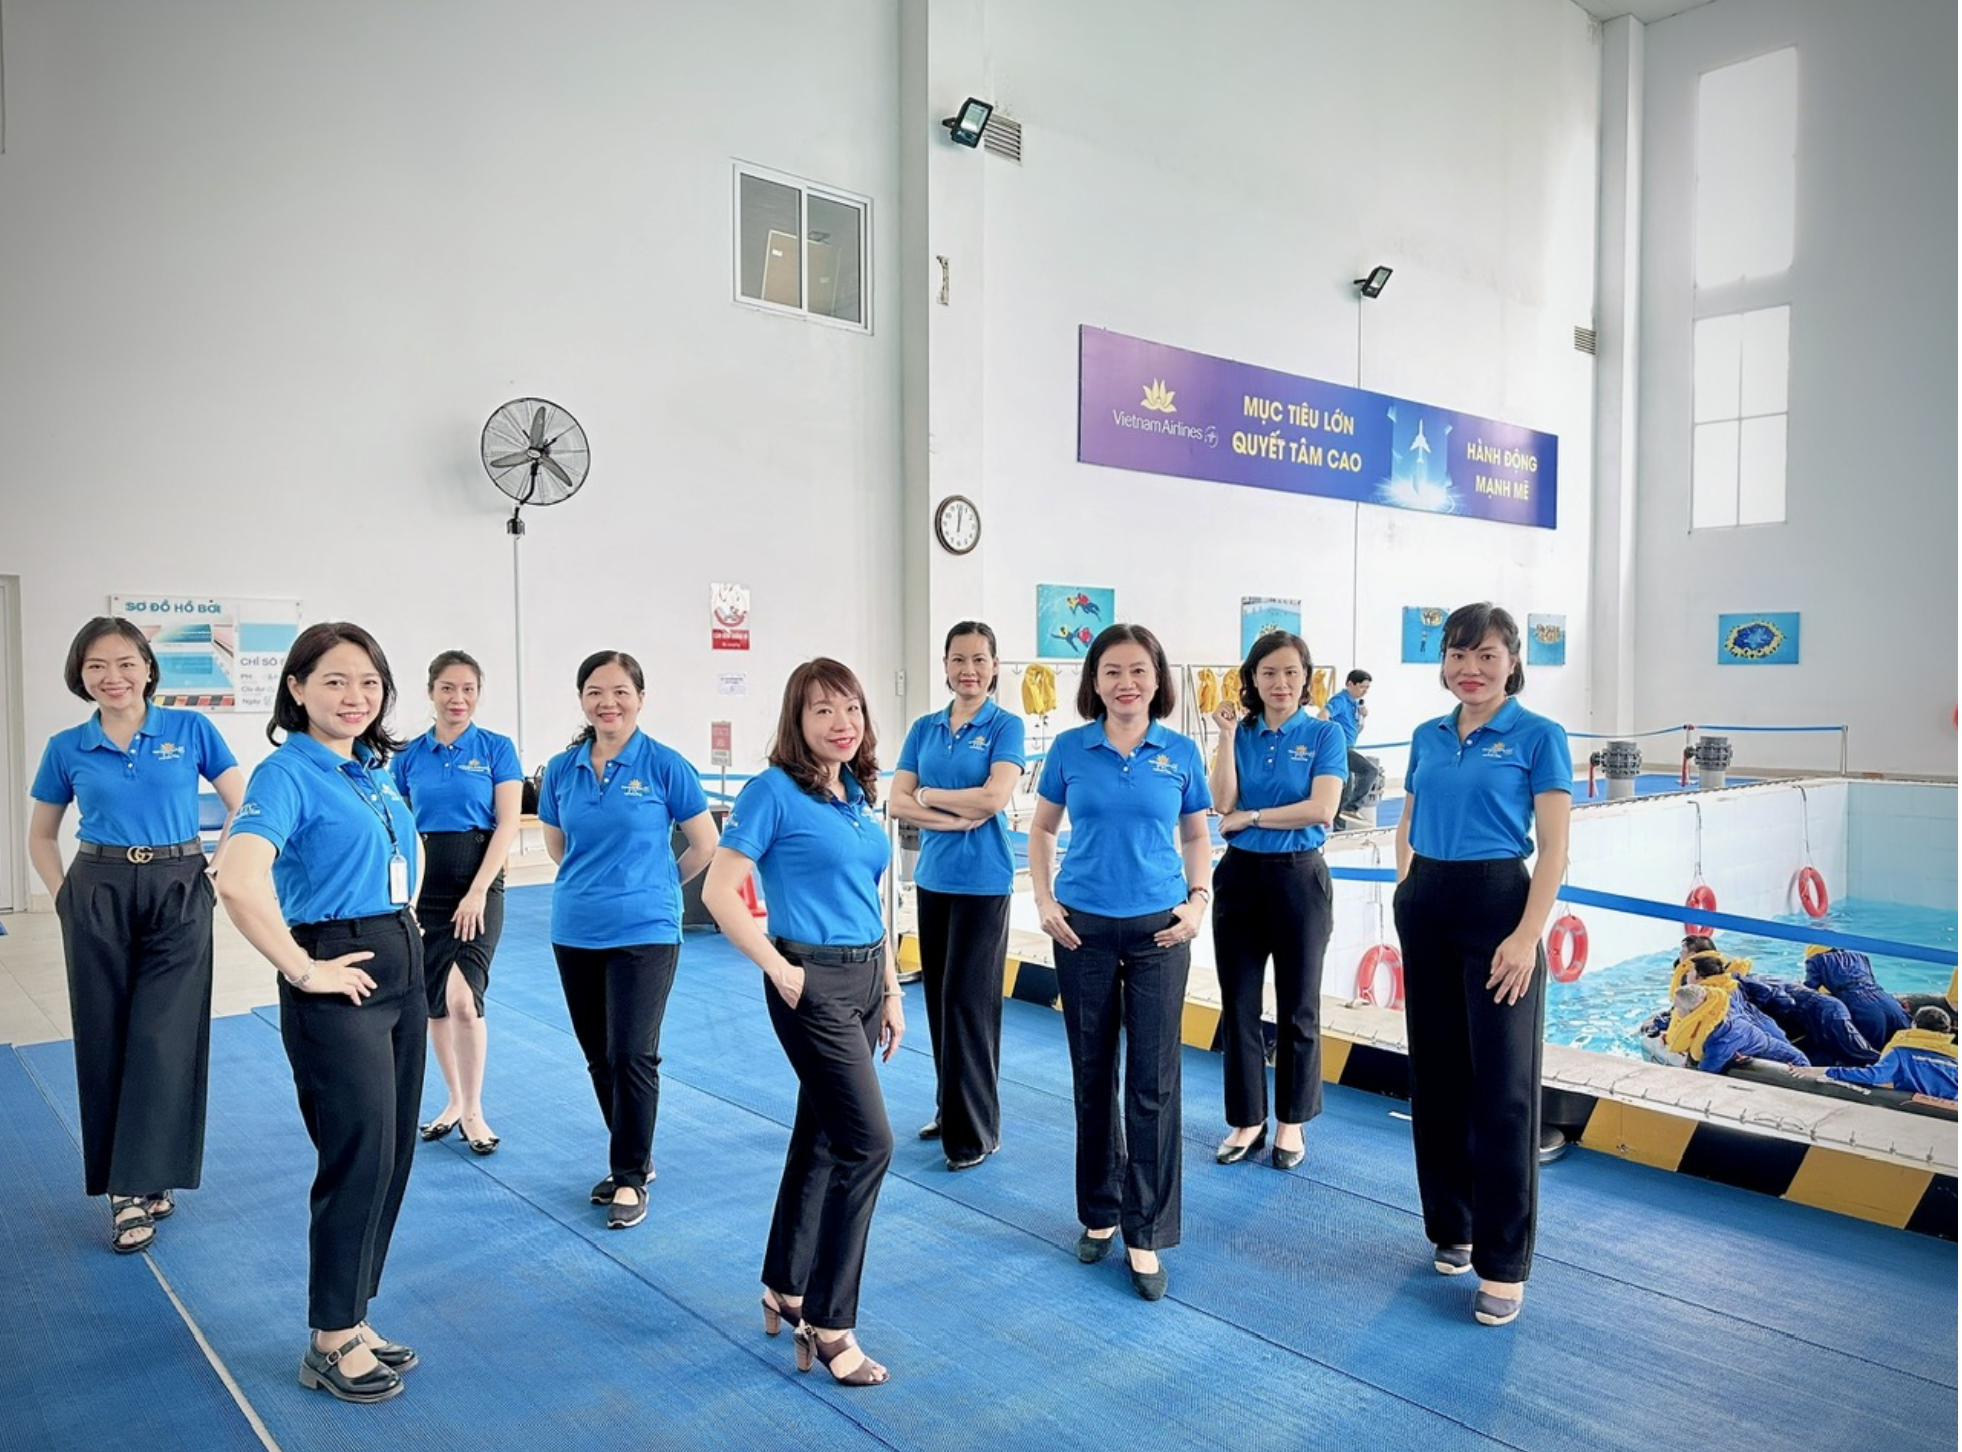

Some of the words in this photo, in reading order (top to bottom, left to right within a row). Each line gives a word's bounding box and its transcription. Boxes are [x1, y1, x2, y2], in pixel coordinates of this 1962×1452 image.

[1113, 409, 1161, 433] Vietnam
[1161, 419, 1204, 440] Airlines
[1243, 395, 1283, 425] MỤC
[1287, 402, 1319, 429] TIÊU
[1324, 408, 1355, 435] LỚN
[1232, 430, 1286, 460] QUYẾT
[1289, 437, 1323, 467] TÂM
[1327, 449, 1362, 473] CAO
[1467, 438, 1501, 466] HÀNH
[1504, 447, 1538, 474] ĐỘNG
[1475, 475, 1511, 499] MẠNH
